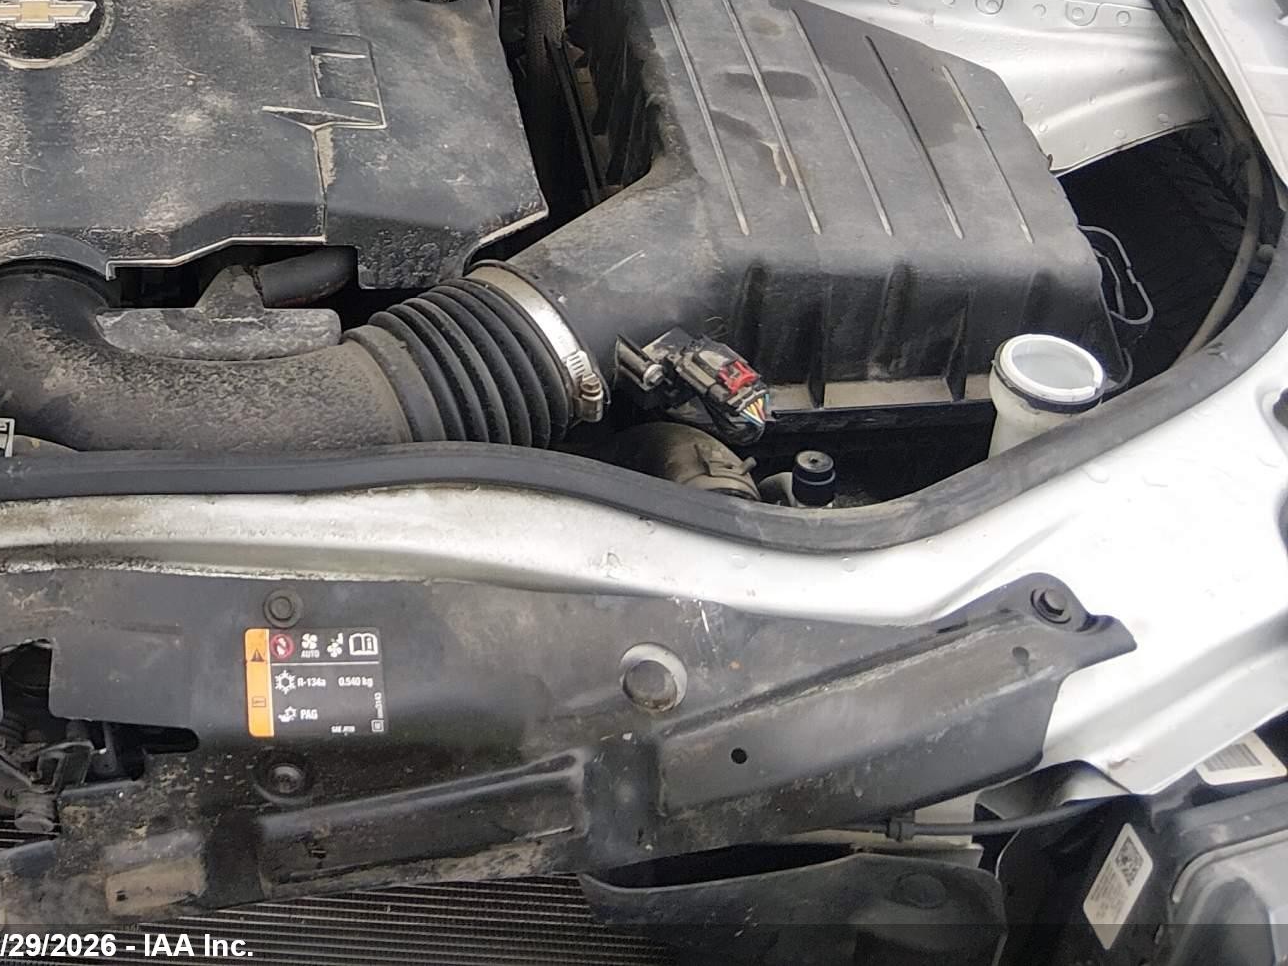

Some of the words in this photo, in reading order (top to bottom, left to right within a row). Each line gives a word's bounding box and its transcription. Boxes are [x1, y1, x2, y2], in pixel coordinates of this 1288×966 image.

[301, 650, 320, 658] AUTO
[297, 677, 326, 687] R-134a
[338, 676, 361, 687] 0.540
[361, 677, 373, 688] kg
[300, 709, 318, 720] PAG
